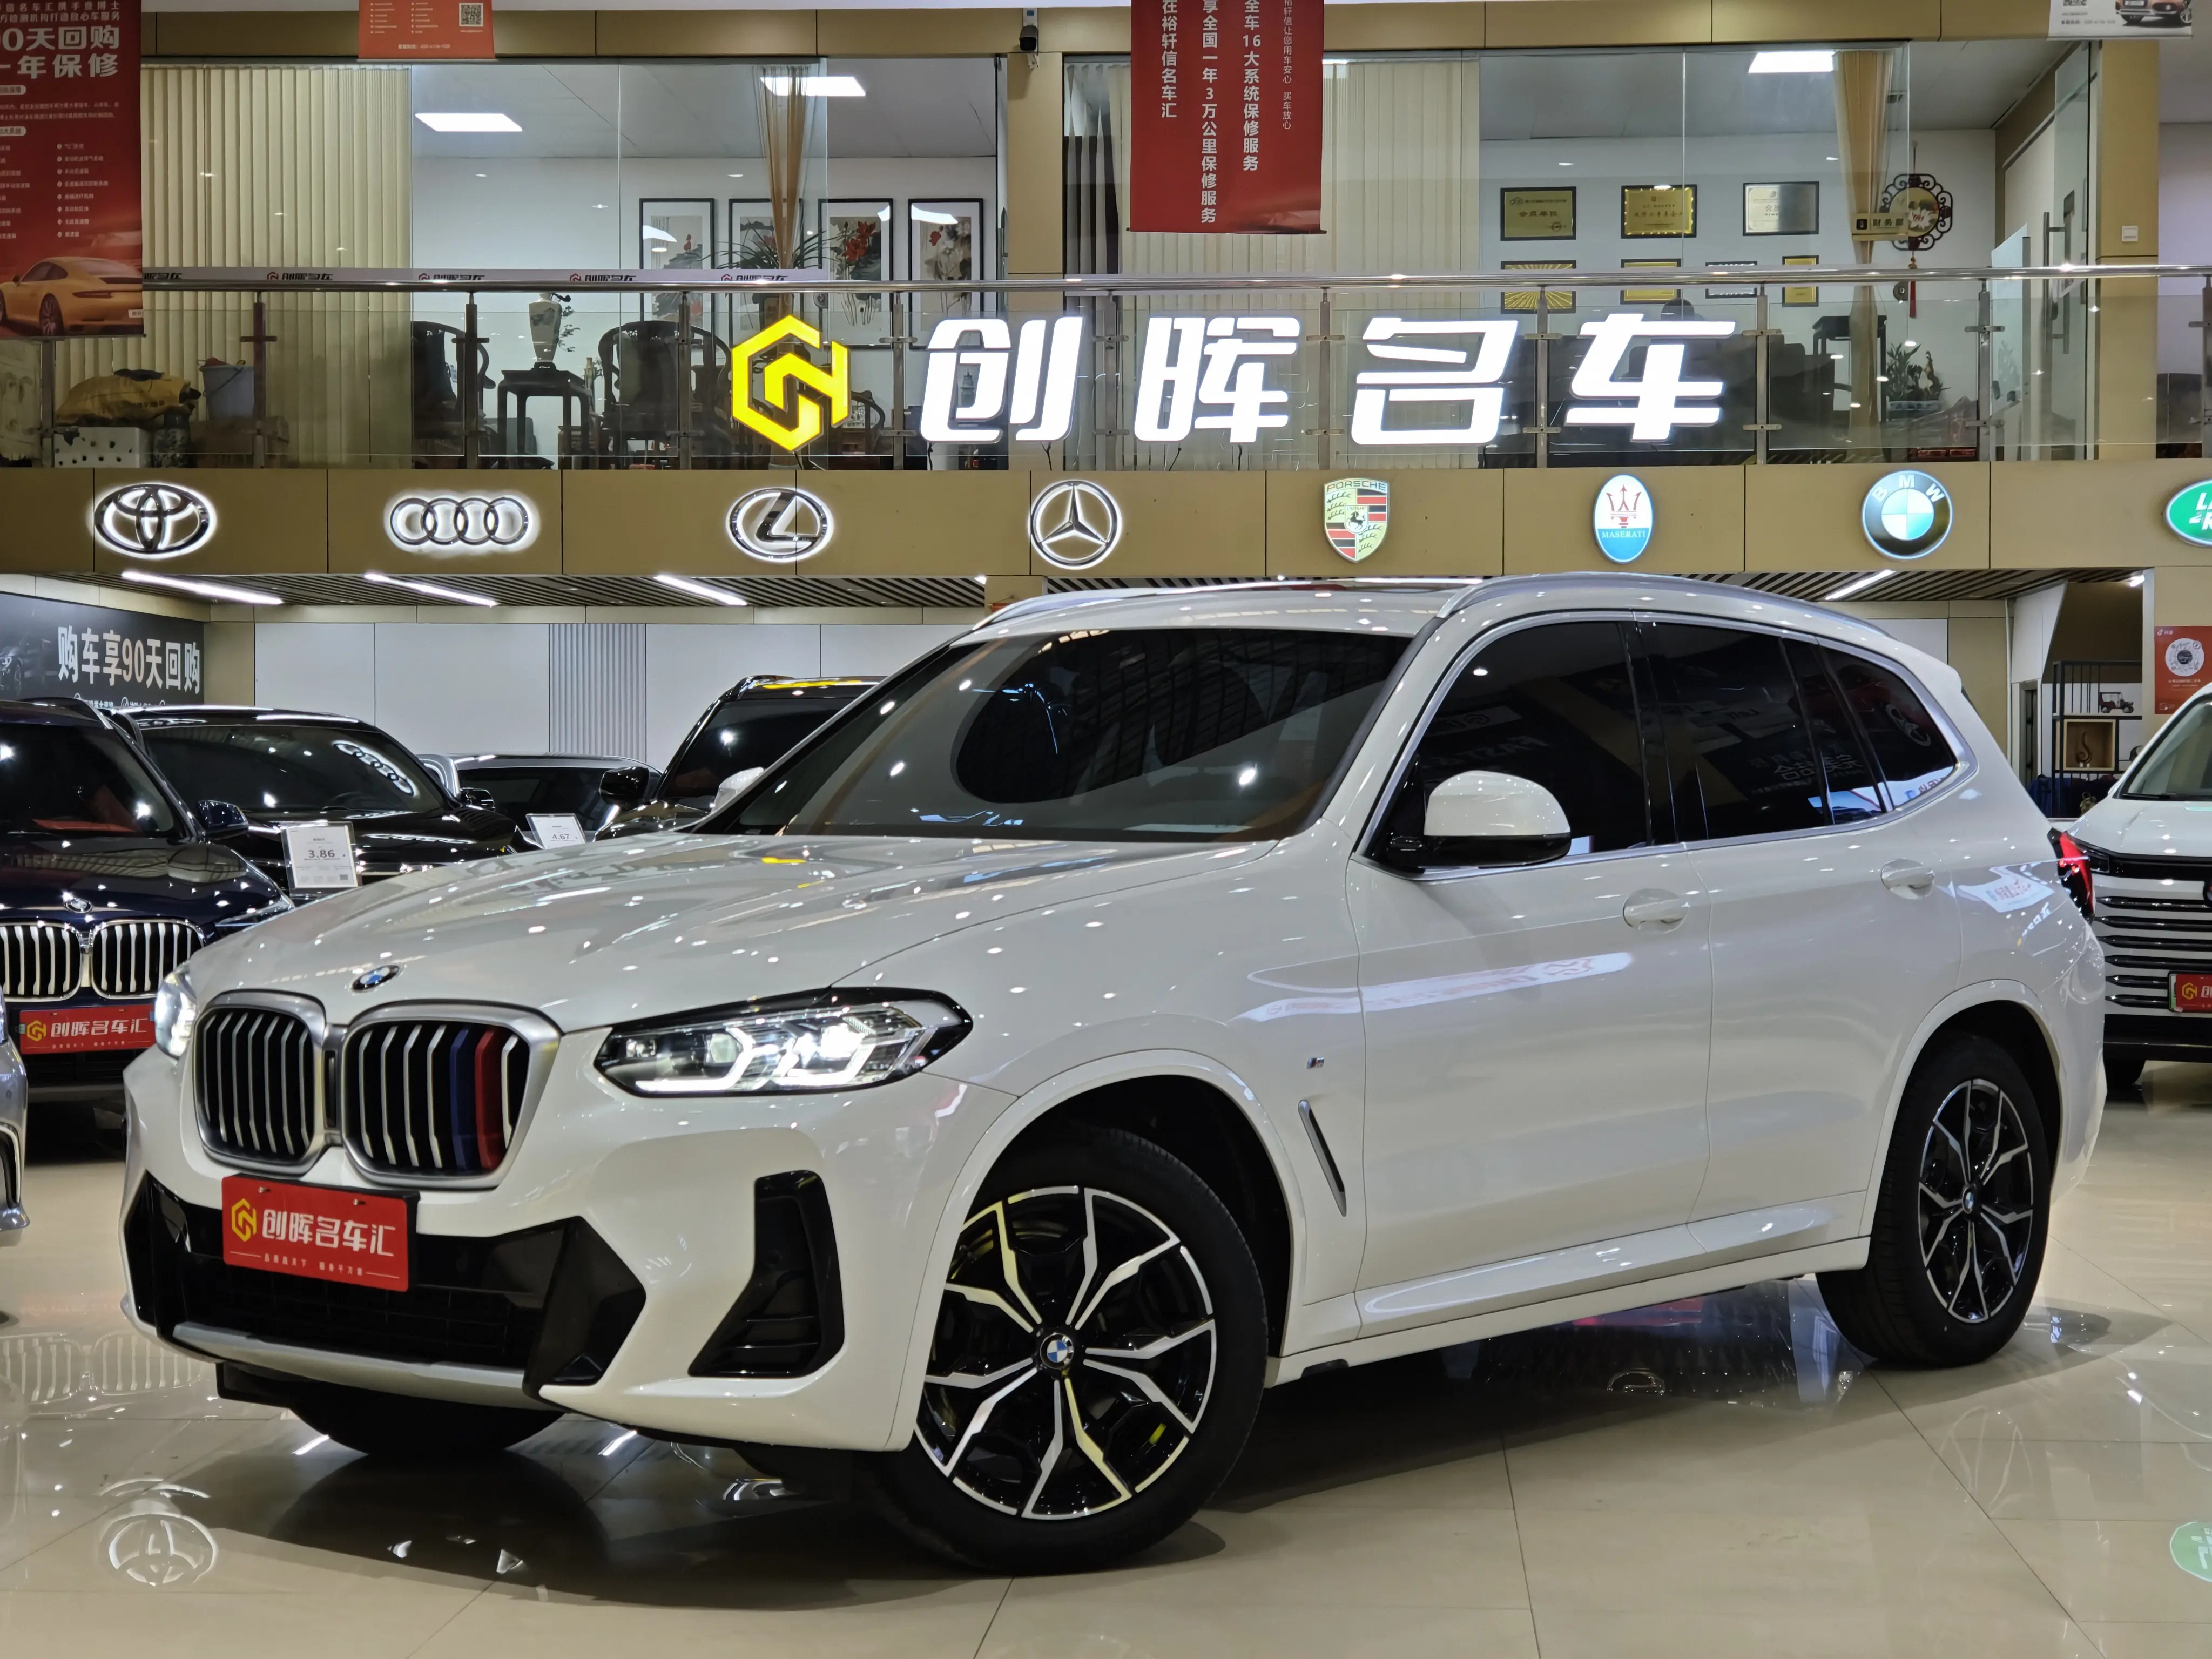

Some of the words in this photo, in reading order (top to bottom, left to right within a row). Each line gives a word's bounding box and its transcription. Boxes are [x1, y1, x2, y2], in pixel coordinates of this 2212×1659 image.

[1161, 0, 1178, 118] 在裕轩信名车汇
[1243, 0, 1261, 171] 全车16大系统保修服务
[1201, 0, 1218, 224] 享全国一年3万公里保修服务
[1283, 91, 1292, 130] 买车放心
[920, 312, 1736, 445] 创晖名车
[1326, 480, 1386, 492] PORSCHE
[1871, 474, 1945, 503] BMW
[1602, 530, 1645, 538] MASERATI
[58, 624, 200, 695] 购车享90天回购
[308, 849, 335, 858] 3.86
[51, 1017, 149, 1037] 创晖名车汇
[262, 1209, 396, 1257] 创晖名车汇
